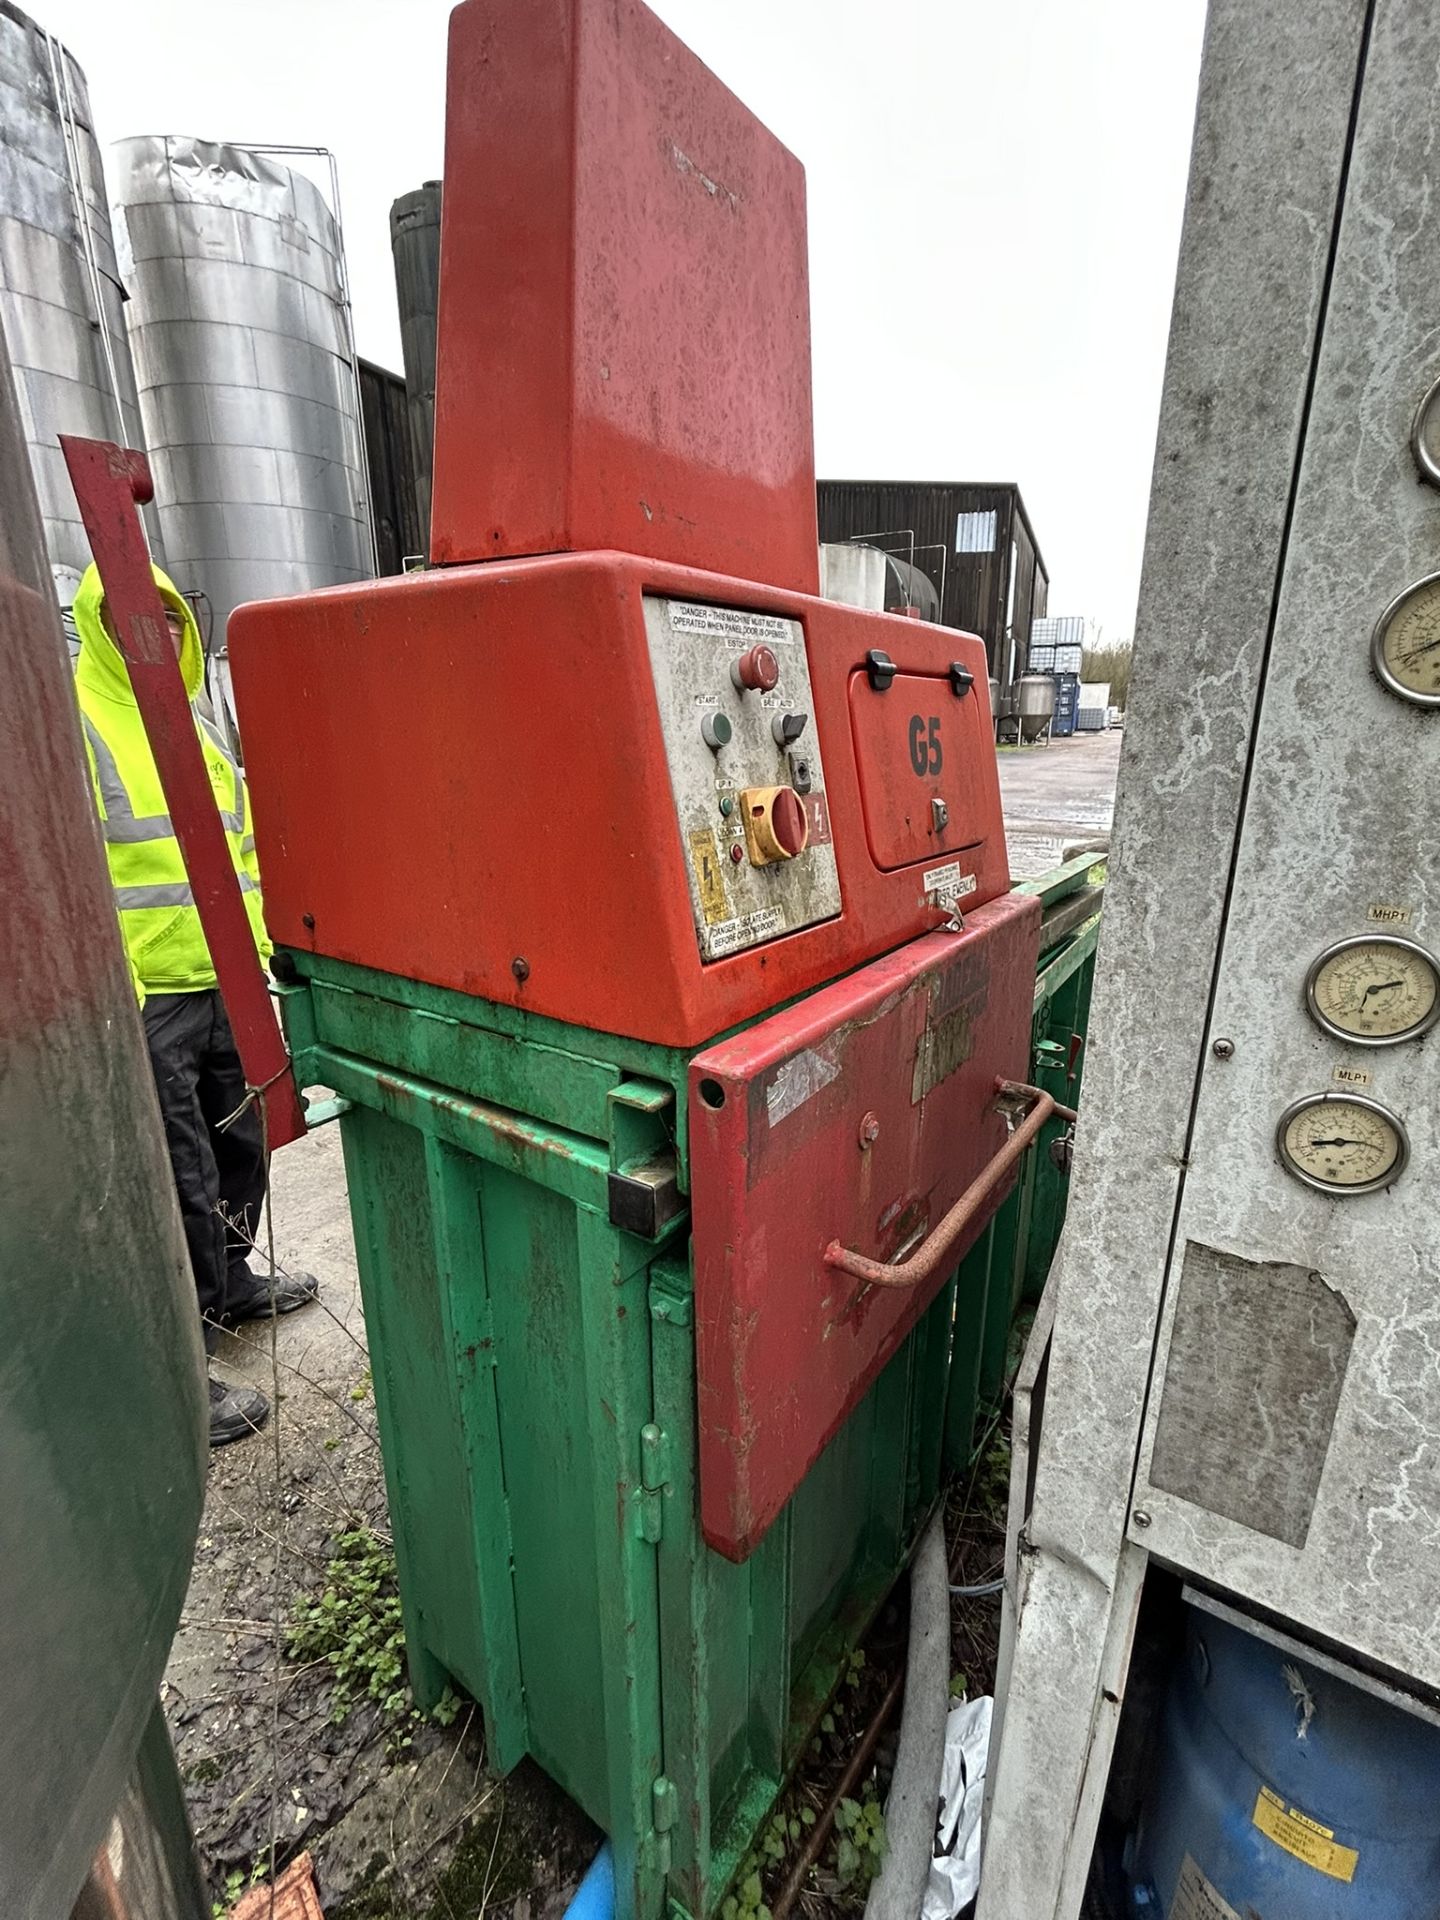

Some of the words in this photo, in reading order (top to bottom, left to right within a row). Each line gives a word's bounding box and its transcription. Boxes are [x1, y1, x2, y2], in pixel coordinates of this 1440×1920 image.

[673, 616, 706, 629] OPERATED
[707, 621, 724, 631] WHEN
[724, 624, 743, 634] PANEL
[743, 626, 758, 637] DOOR
[759, 628, 764, 636] IS
[713, 611, 726, 621] THIS
[726, 613, 750, 625] MACHINE
[751, 617, 765, 627] MUST
[765, 619, 776, 628] NOT
[776, 621, 784, 630] BE
[699, 695, 716, 705] START
[909, 714, 943, 777] G5
[1372, 908, 1407, 921] MHP1
[714, 932, 736, 949] BEFORE
[1338, 1070, 1368, 1083] MLP1
